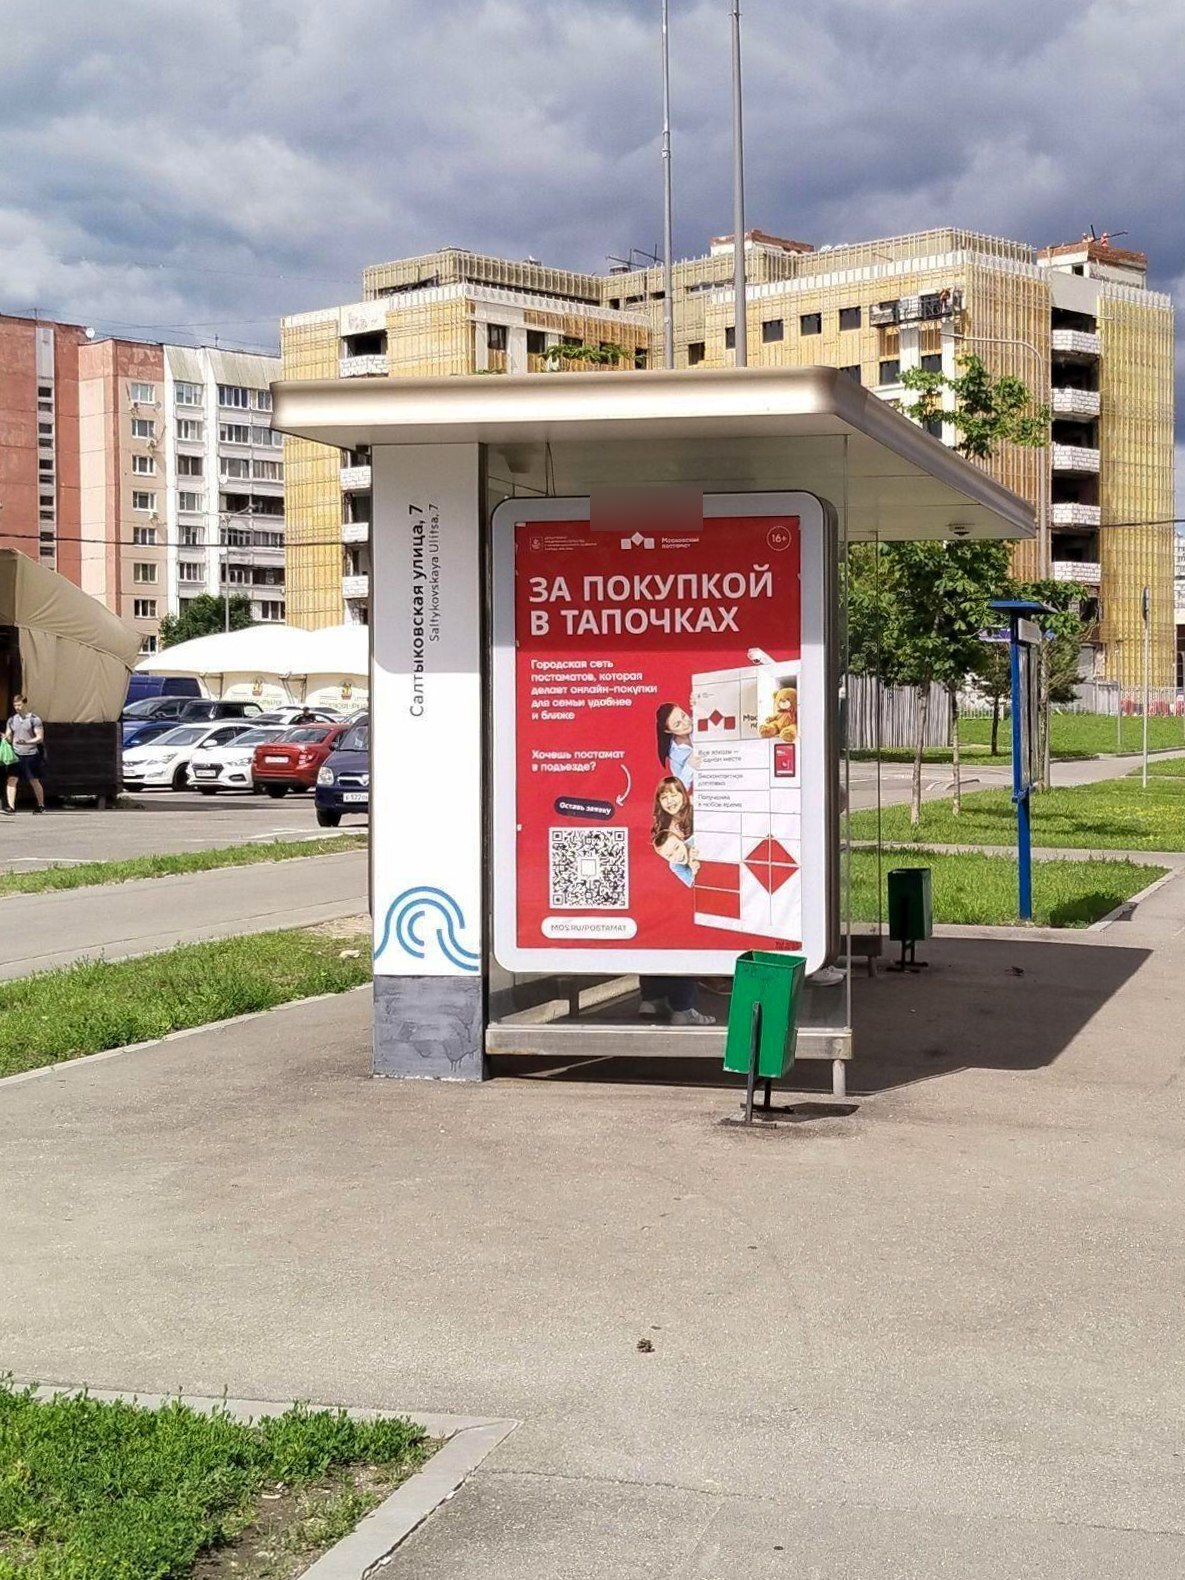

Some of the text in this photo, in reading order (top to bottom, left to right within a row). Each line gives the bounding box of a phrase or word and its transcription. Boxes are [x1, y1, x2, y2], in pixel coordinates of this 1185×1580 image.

[772, 534, 788, 543] 16+
[529, 563, 773, 602] ЗА ПОКУПКОЙ
[428, 556, 442, 642] Saltykovskaya
[408, 504, 428, 717] Салтыковская улица, 7
[530, 606, 740, 636] В ТАПОЧКАХ
[531, 660, 614, 670] Городская сеть
[531, 672, 642, 682] постаматов, которая
[531, 684, 658, 696] делает онлайн-покупки
[531, 697, 632, 709] для семьи удобнее
[532, 710, 576, 720] и ближе
[532, 750, 625, 760] Хочешь постамат
[532, 761, 596, 772] в подъезде?
[560, 802, 585, 812] Оставь
